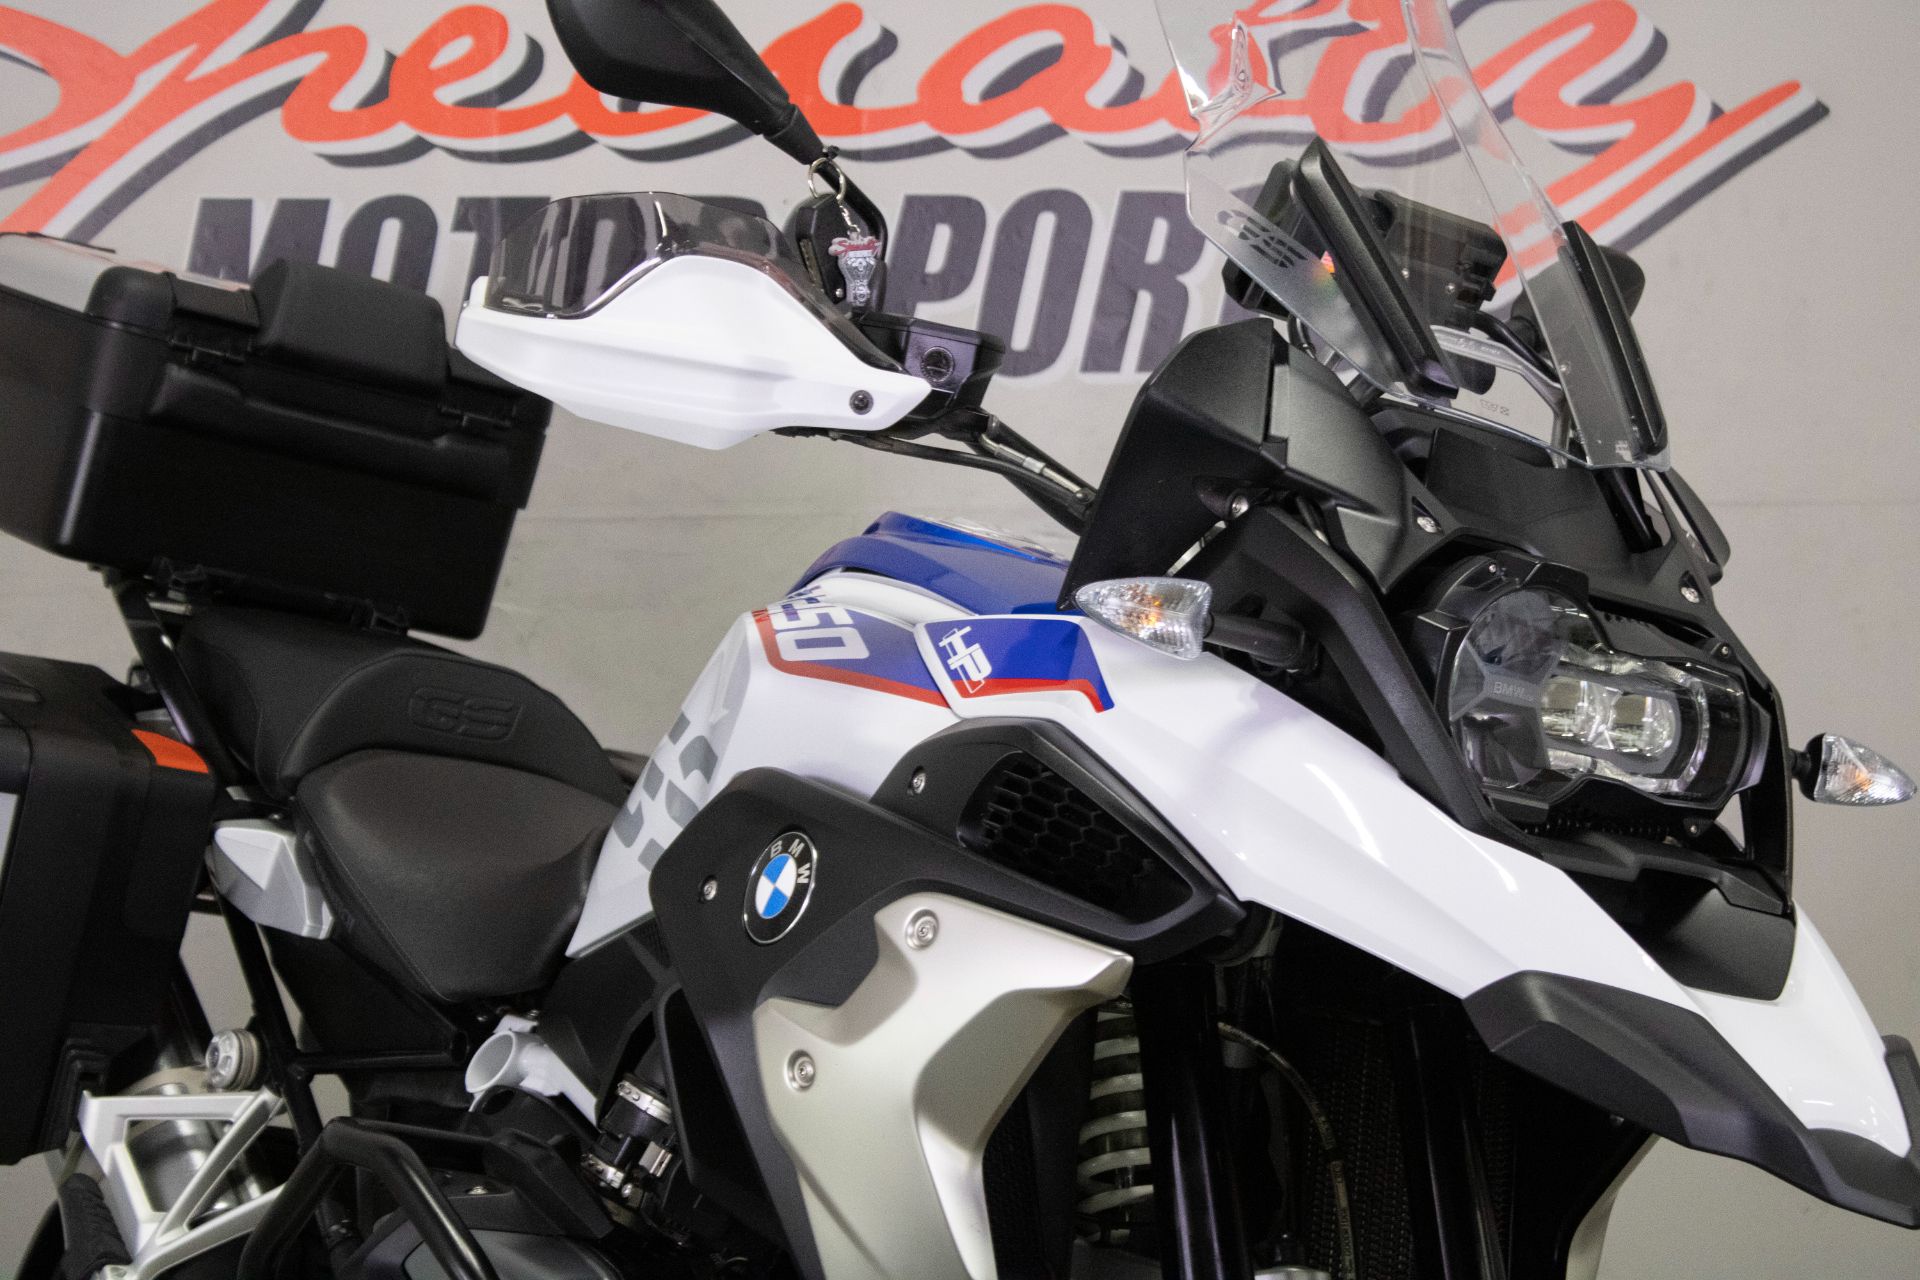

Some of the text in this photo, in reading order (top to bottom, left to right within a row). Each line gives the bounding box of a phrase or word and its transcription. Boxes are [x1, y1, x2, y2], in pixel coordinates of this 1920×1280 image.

[0, 0, 1829, 294] peiaty
[409, 687, 523, 740] GS
[1494, 681, 1526, 697] BMW
[770, 838, 812, 884] BMW
